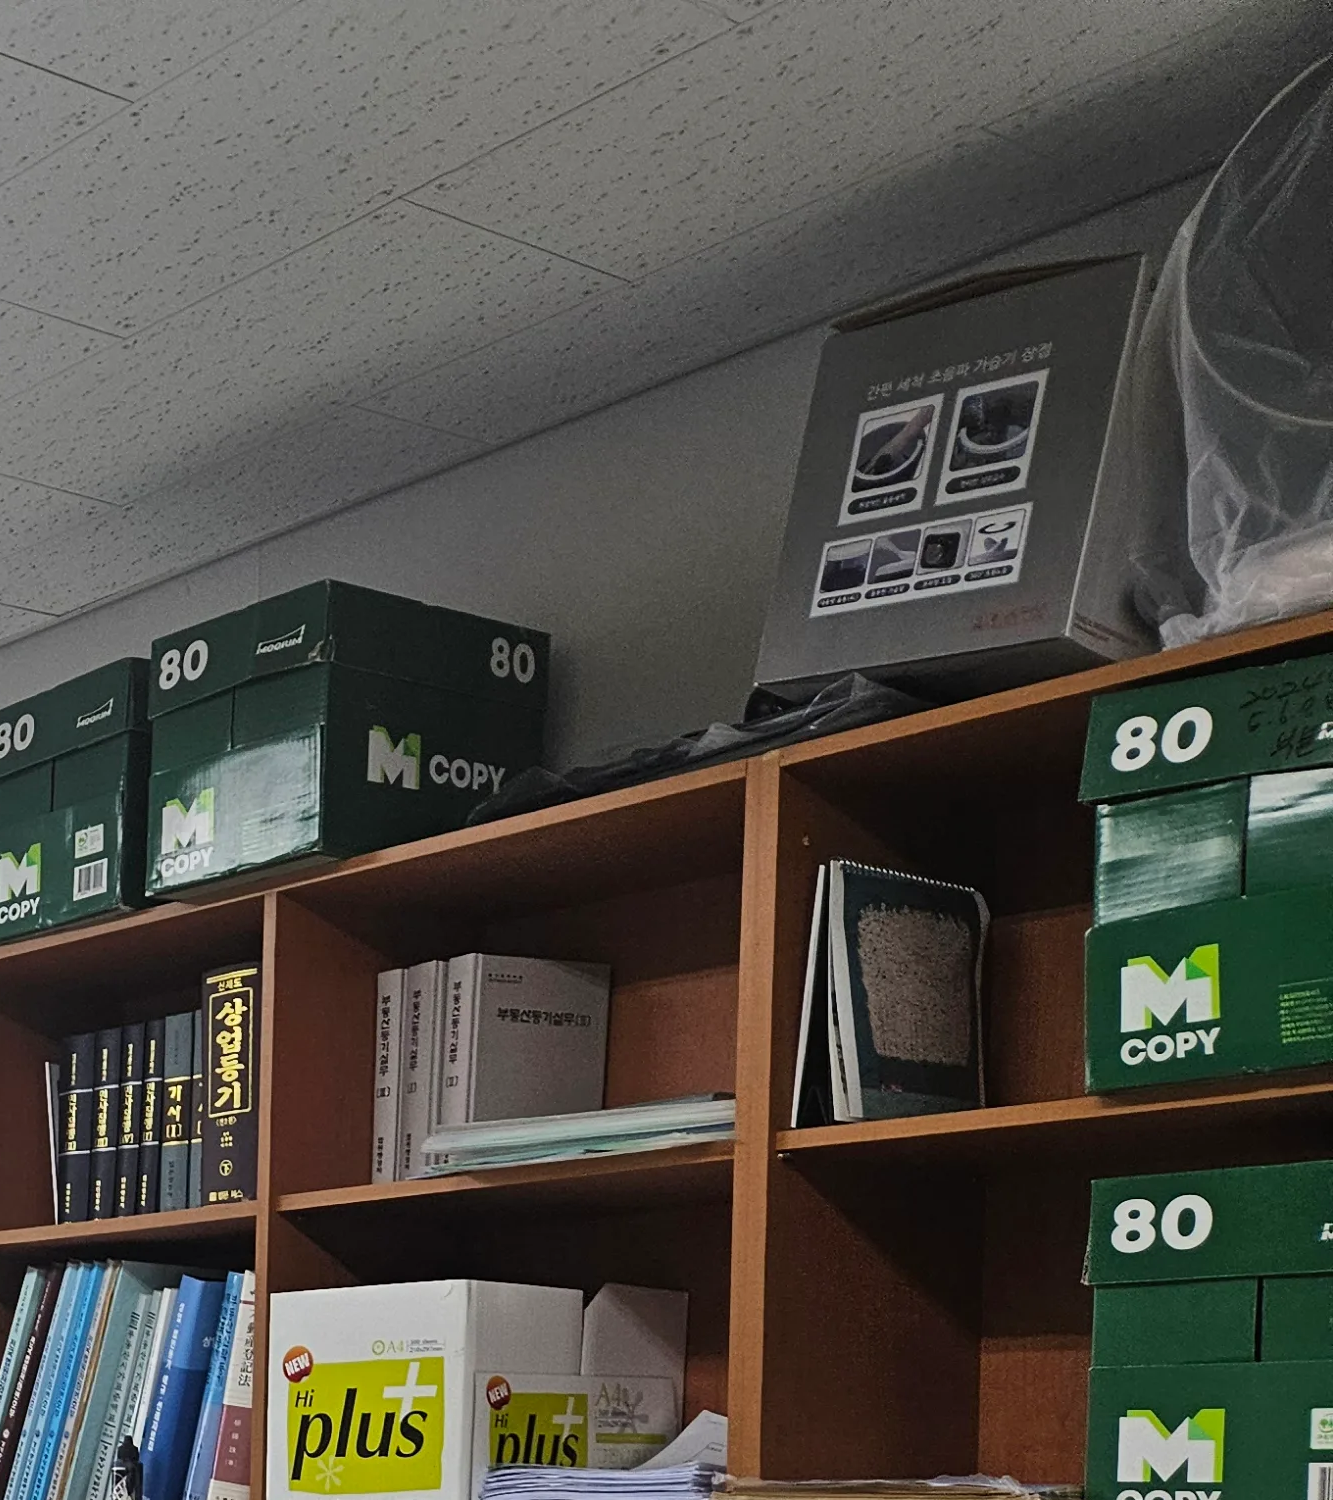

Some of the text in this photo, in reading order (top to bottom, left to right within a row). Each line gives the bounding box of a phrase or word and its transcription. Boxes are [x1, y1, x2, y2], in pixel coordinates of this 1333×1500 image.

[158, 639, 209, 691] 80
[489, 636, 536, 684] 80
[1110, 706, 1213, 772] 80
[428, 754, 507, 795] COPY
[160, 847, 214, 880] COPY
[1120, 943, 1221, 1033] M
[214, 997, 249, 1109] 상업등기
[1120, 1027, 1221, 1067] COPY
[1110, 1194, 1213, 1254] 80
[285, 1354, 310, 1374] NEW
[294, 1389, 315, 1408] Hi
[488, 1384, 511, 1403] NEW
[291, 1387, 427, 1481] plus
[494, 1414, 509, 1428] Hi
[495, 1413, 579, 1467] plus
[1116, 1408, 1226, 1483] M
